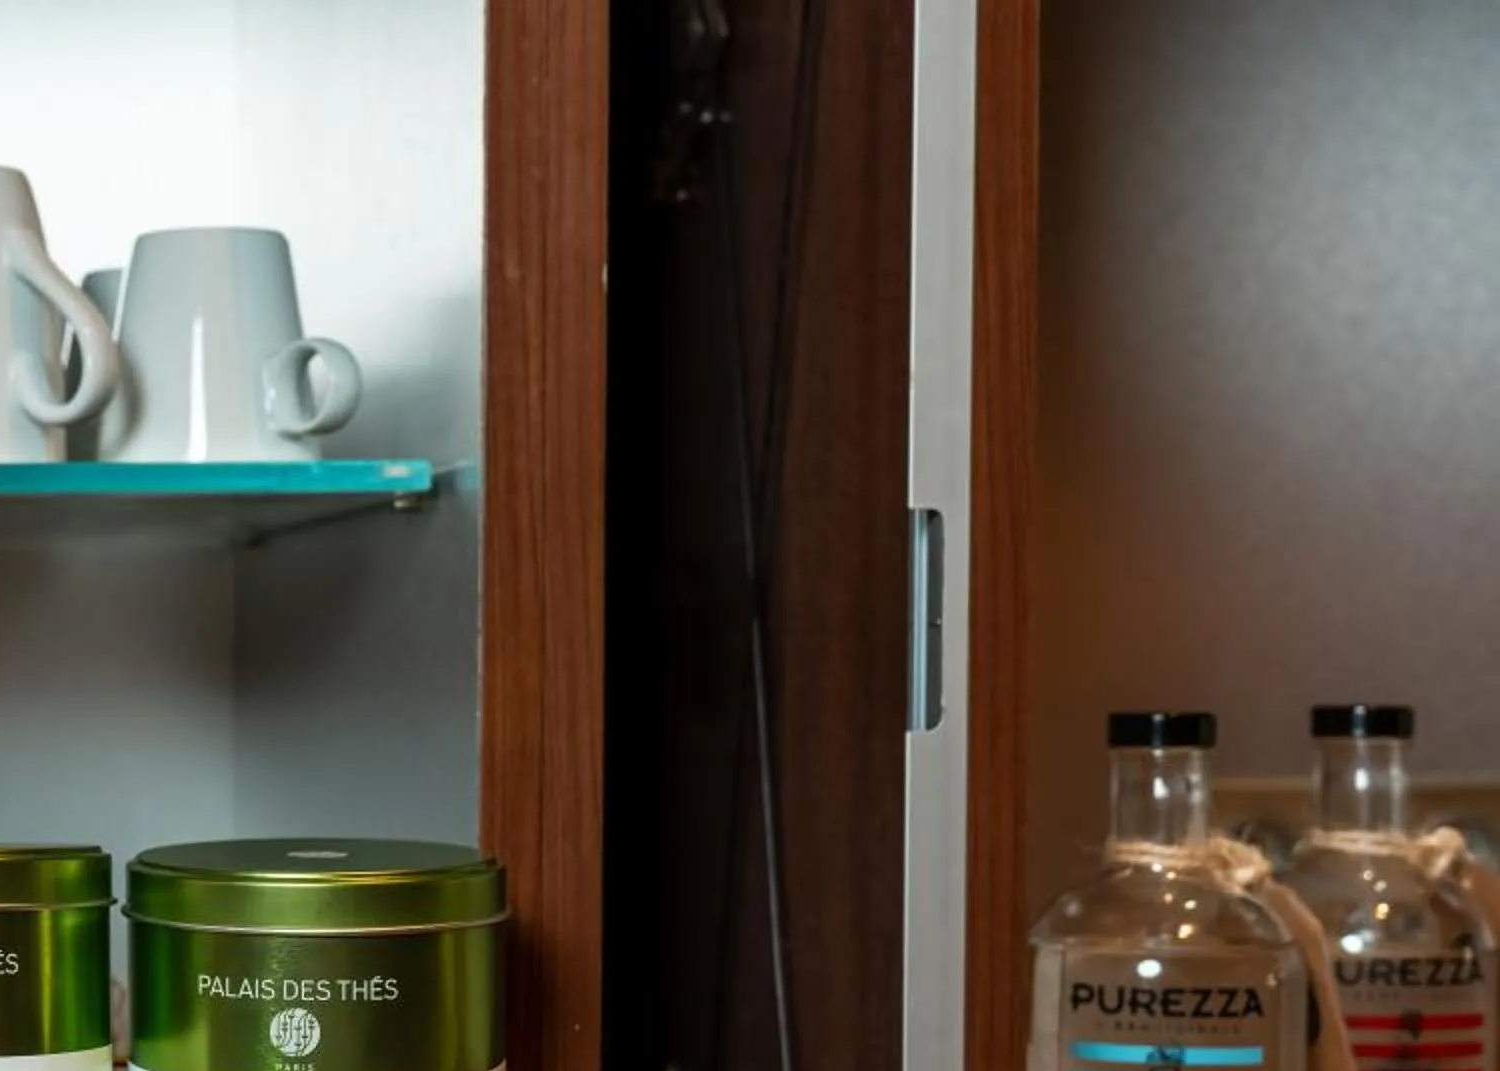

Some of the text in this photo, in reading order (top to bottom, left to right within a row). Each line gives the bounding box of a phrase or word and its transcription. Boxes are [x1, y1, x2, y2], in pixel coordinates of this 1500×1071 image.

[1332, 956, 1485, 986] UREZZA
[198, 975, 399, 1001] PALAIS DES THÉS
[1071, 982, 1265, 1018] PUREZZA
